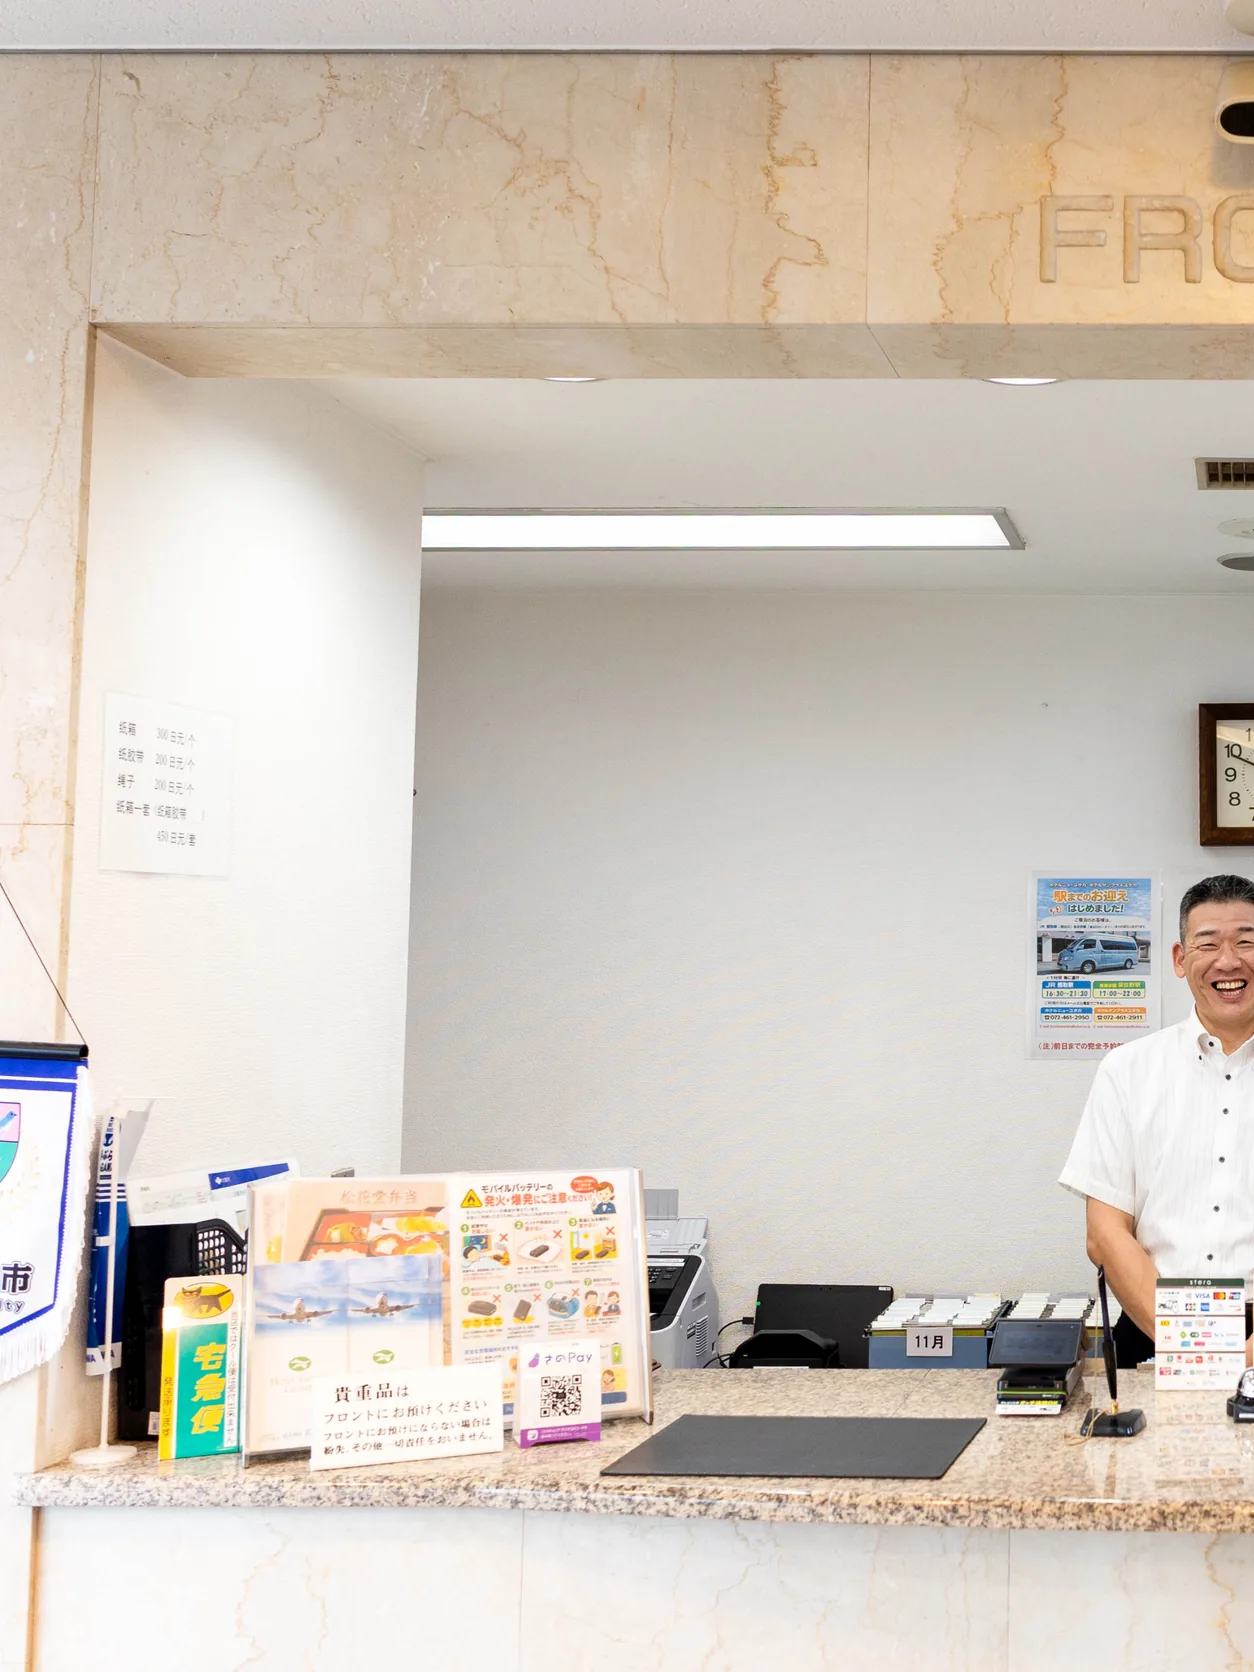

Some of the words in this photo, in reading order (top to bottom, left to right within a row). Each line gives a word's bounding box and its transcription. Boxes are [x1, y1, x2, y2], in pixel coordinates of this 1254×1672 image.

[1224, 744, 1242, 758] 10
[1225, 767, 1237, 782] 9
[1229, 792, 1241, 806] 8
[1053, 890, 1128, 902] 駅までのお迎え
[481, 1183, 553, 1194] モバイルバッテリーの
[2, 1263, 32, 1293] 市
[915, 1334, 945, 1350] 11月
[191, 1342, 227, 1435] 宅急便
[334, 1382, 409, 1403] 貴重品は
[324, 1399, 488, 1424] フロントにお預けください
[324, 1417, 491, 1441] フロントにお預けにならない場合は
